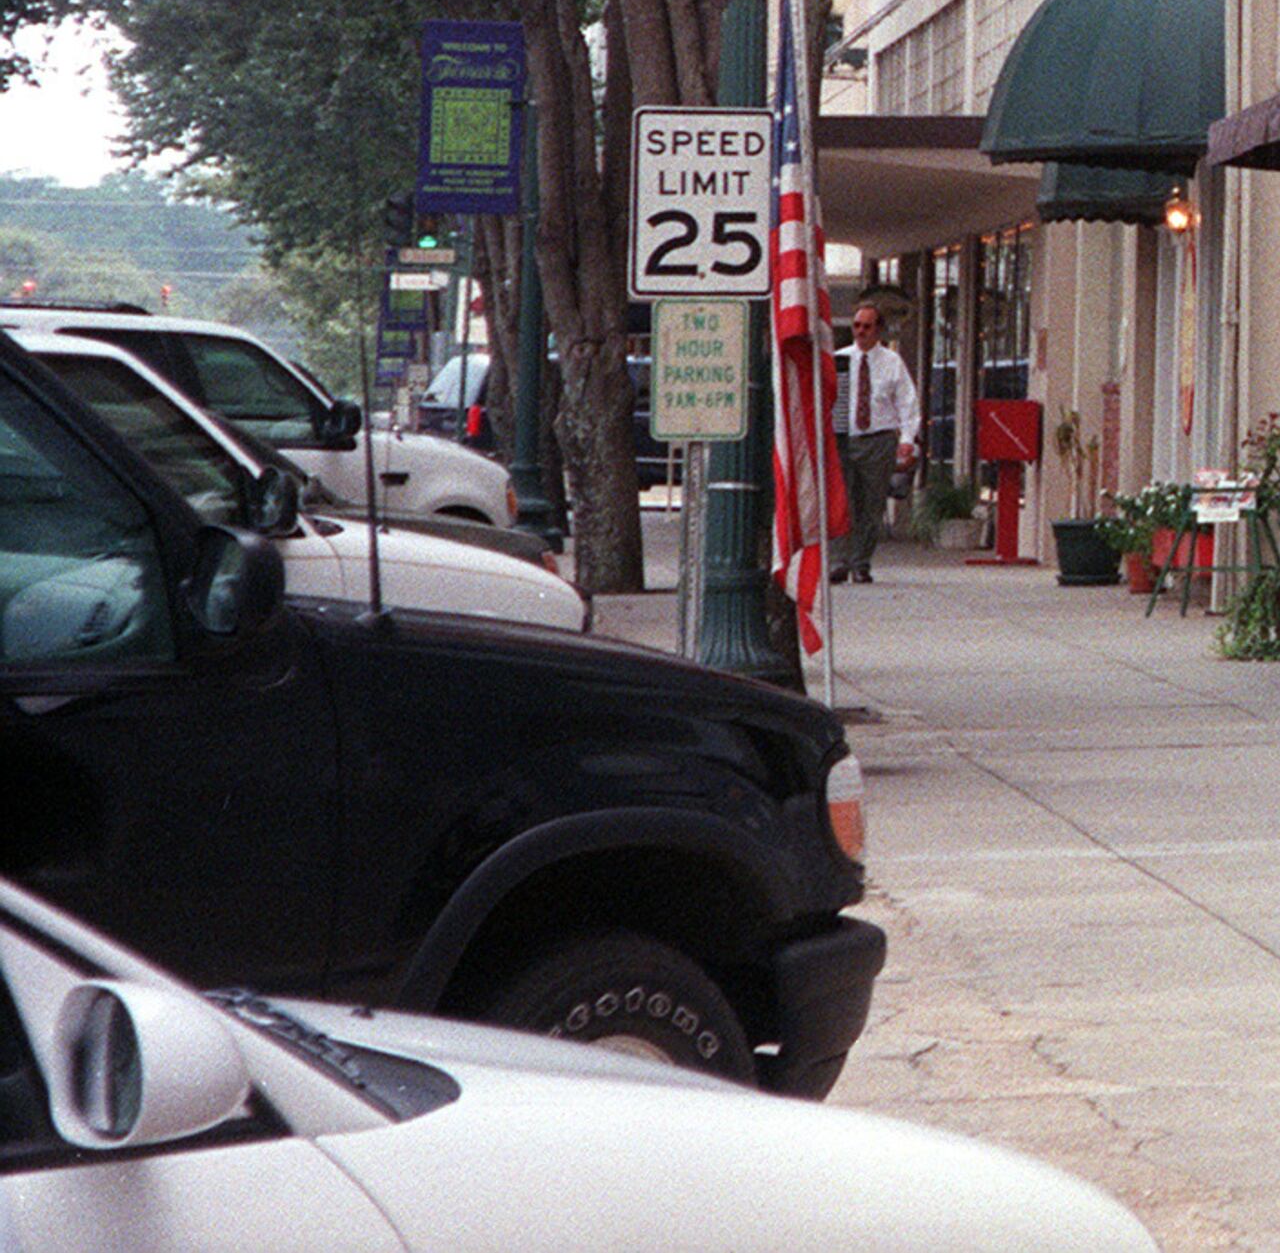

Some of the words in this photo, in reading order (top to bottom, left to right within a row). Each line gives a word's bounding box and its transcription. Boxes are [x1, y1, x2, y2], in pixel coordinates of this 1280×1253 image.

[647, 130, 765, 156] SPEED
[658, 170, 751, 196] LIMIT
[644, 209, 763, 277] 25
[682, 312, 720, 332] TWO
[675, 339, 724, 358] HOUR
[663, 364, 735, 384] PARKING
